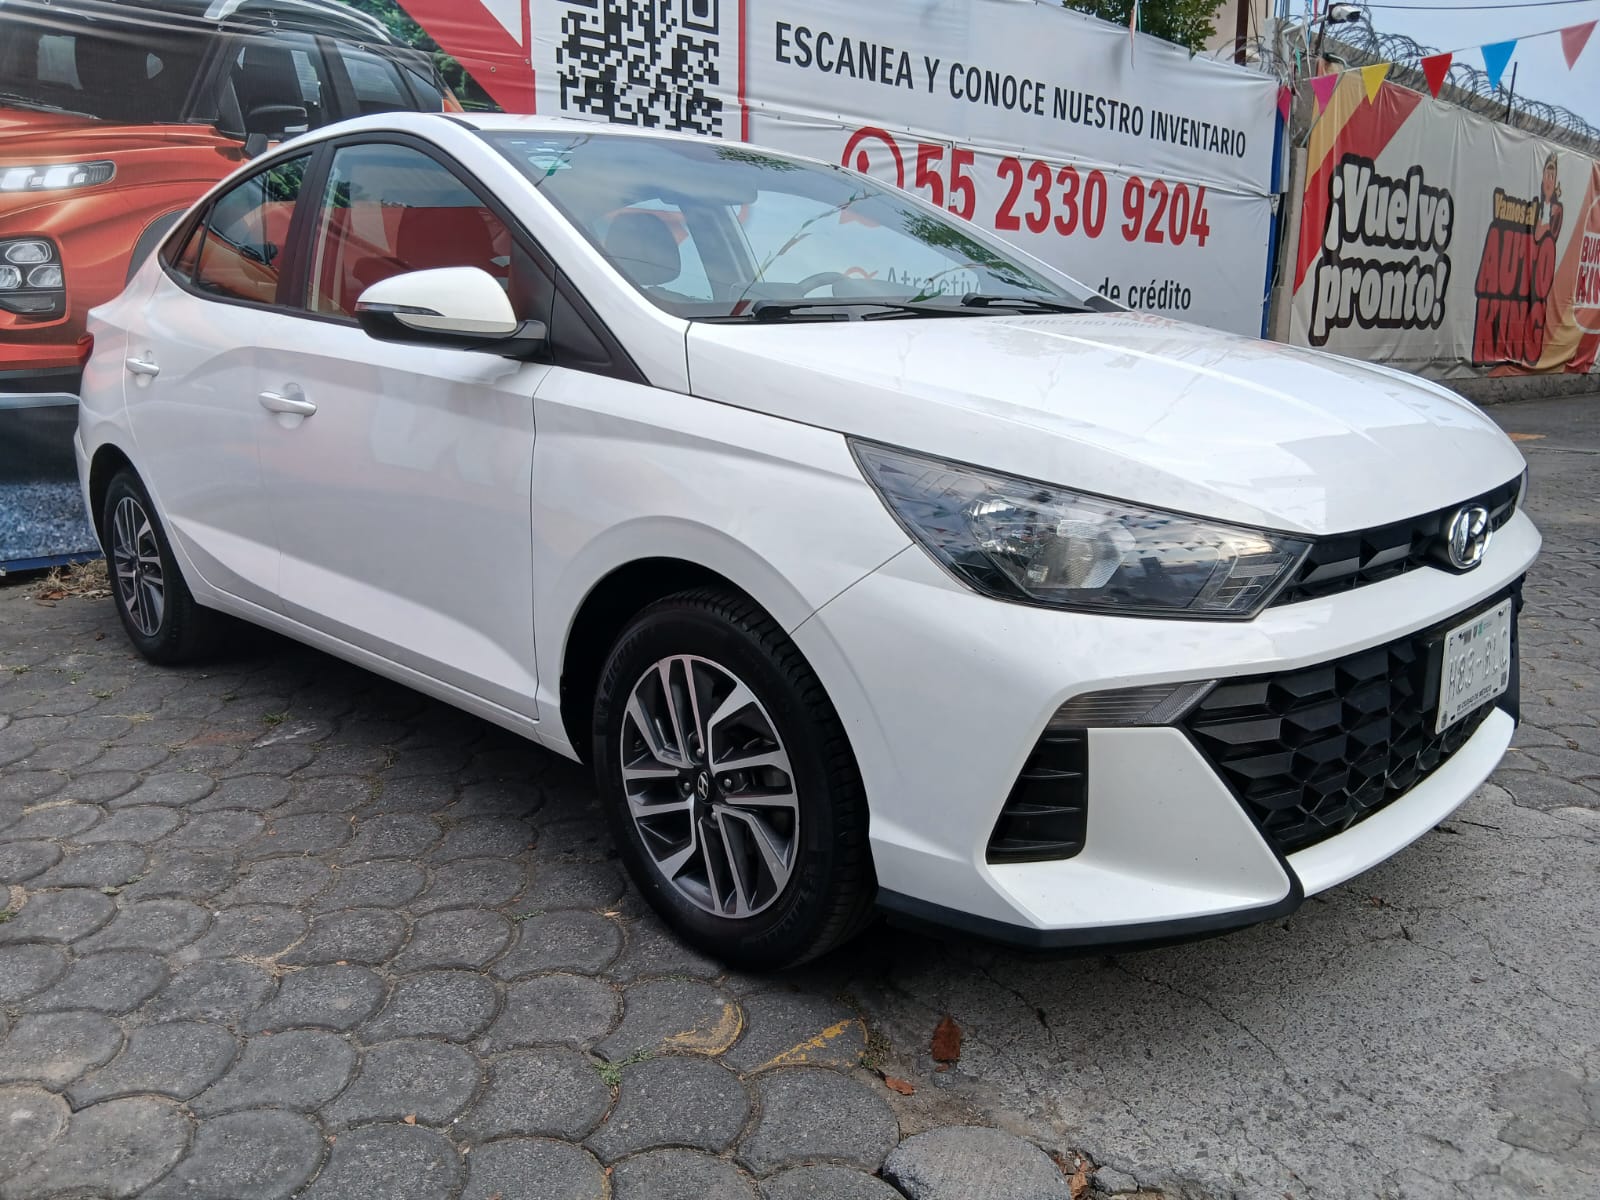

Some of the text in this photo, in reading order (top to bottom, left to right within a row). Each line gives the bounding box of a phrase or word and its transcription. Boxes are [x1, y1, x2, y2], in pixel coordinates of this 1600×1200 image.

[776, 21, 1246, 158] ESCANEA Y CONOCE NUESTRO INVENTARIO
[916, 144, 1210, 247] 55 2330 9204
[1323, 155, 1452, 253] ¡Vuelve
[1098, 277, 1120, 300] de
[1128, 279, 1191, 310] crédito
[1310, 256, 1449, 341] pronto!
[1476, 227, 1556, 298] AUTO
[1473, 297, 1546, 363] KING
